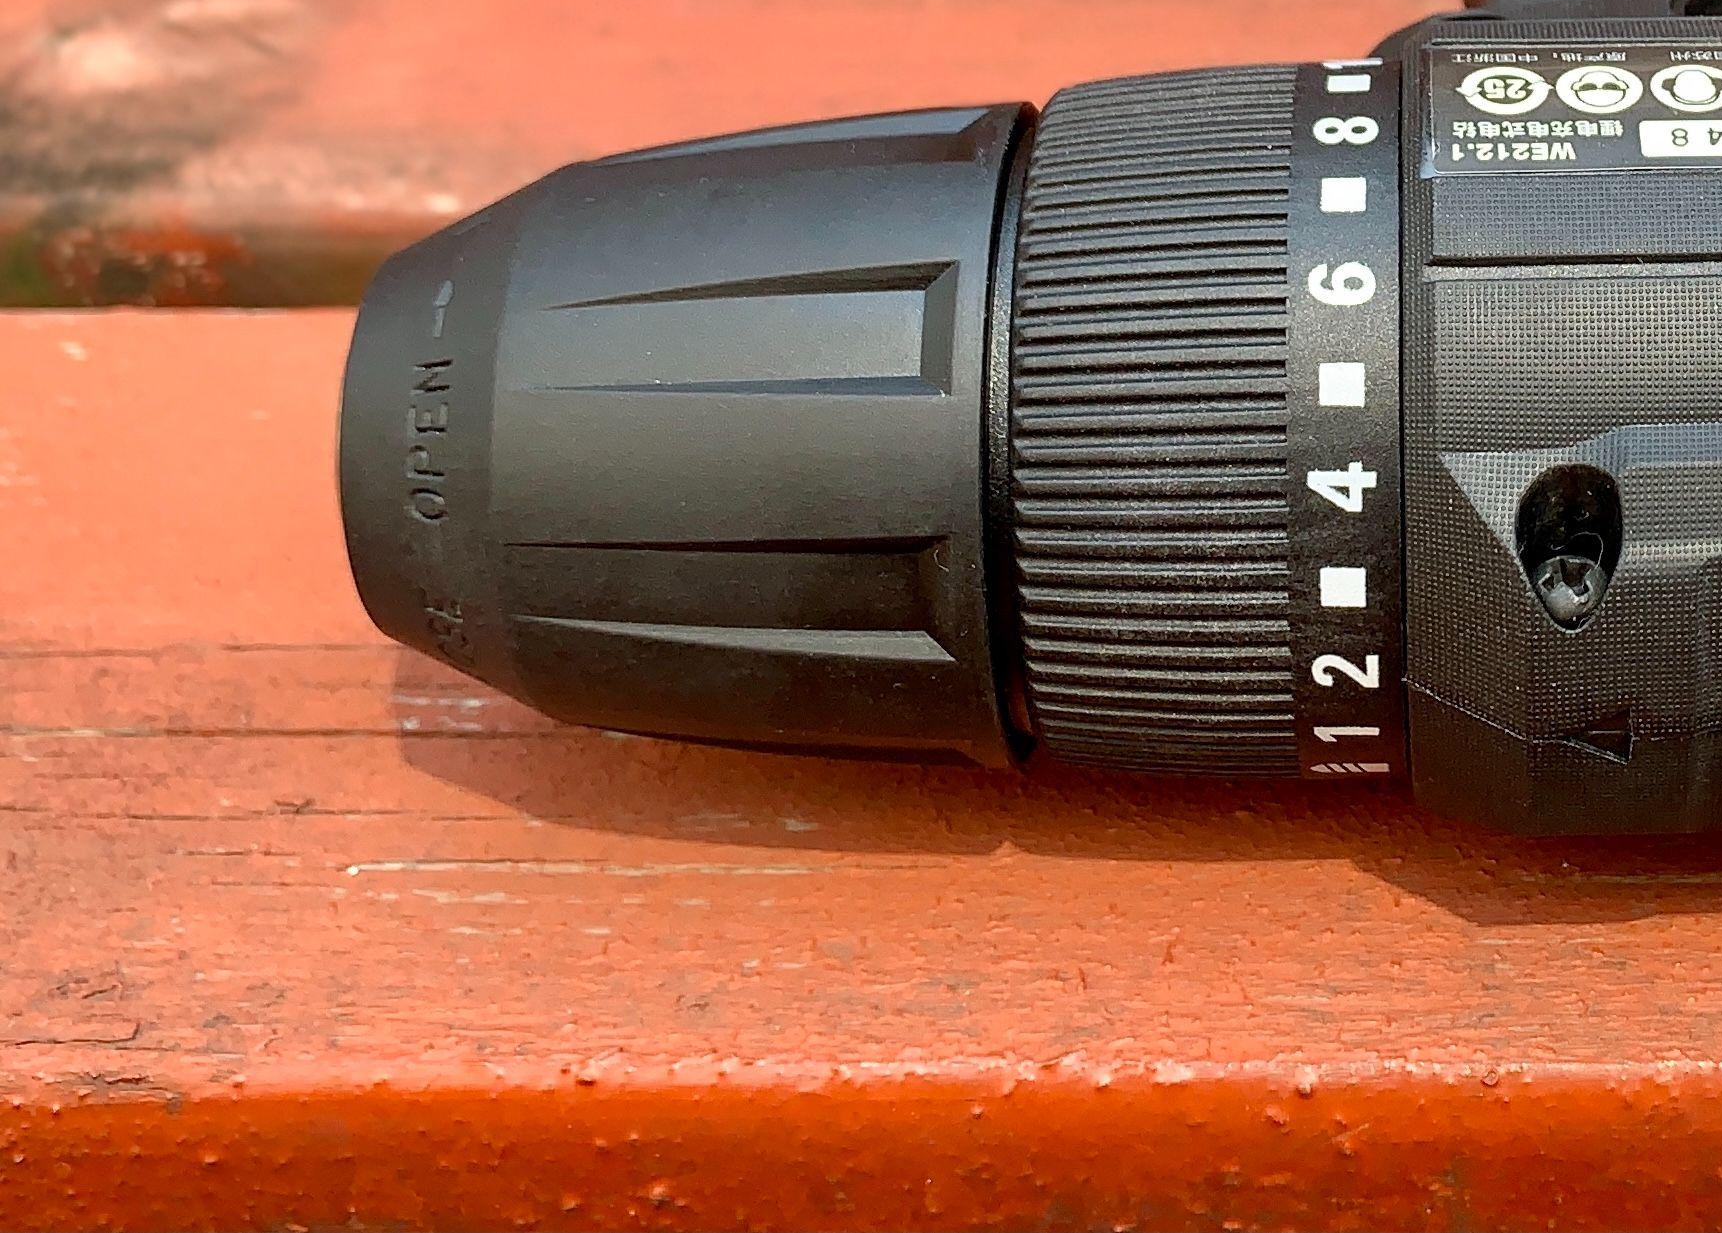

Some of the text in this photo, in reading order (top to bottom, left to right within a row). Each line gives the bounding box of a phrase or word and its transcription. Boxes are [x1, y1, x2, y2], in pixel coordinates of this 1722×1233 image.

[1483, 77, 1527, 100] 25
[1312, 115, 1380, 146] 8
[1452, 119, 1624, 139] 锂电充电式电钻
[1452, 141, 1577, 162] WE212.1
[1308, 260, 1377, 307] 6
[406, 358, 454, 525] OPEN
[1307, 460, 1378, 514] 4
[1310, 653, 1380, 689] 2
[1312, 725, 1381, 743] 1
